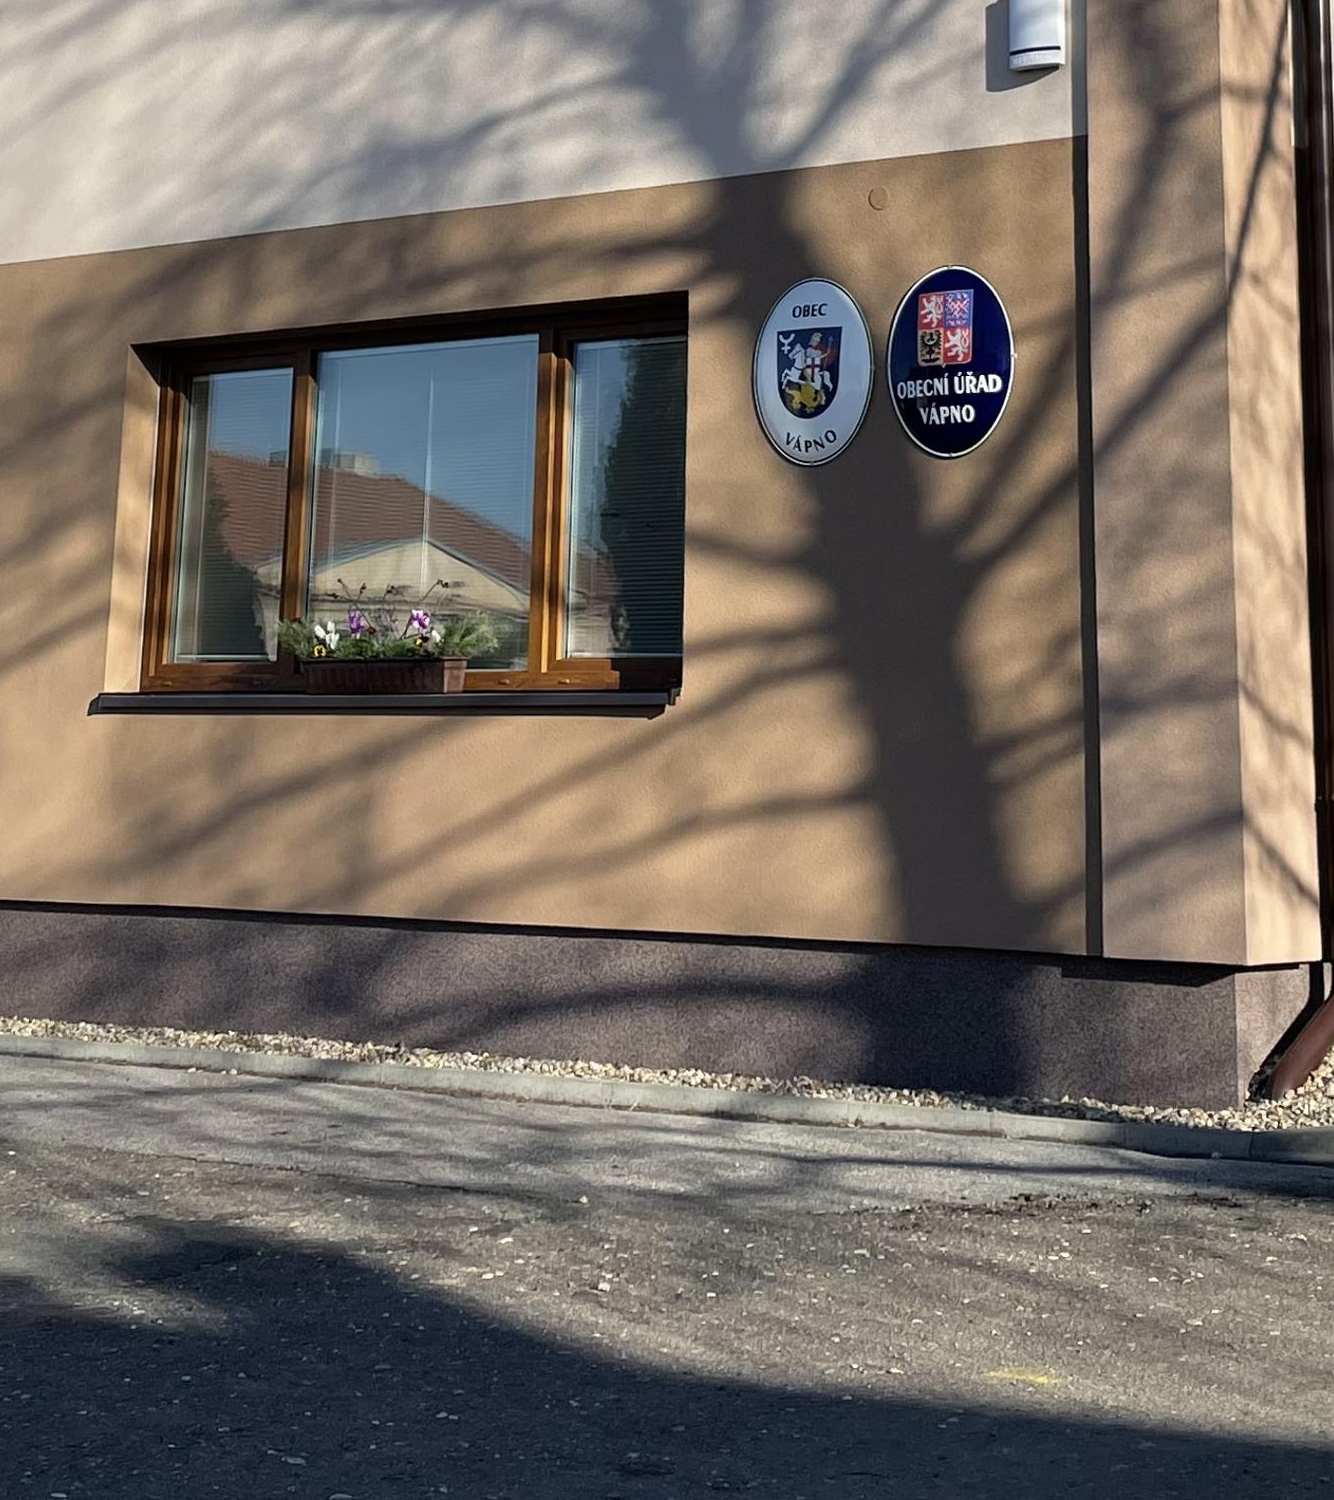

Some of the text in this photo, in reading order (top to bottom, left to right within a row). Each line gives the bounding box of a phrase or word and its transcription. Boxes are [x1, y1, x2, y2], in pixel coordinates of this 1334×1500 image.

[792, 303, 828, 318] OBEC
[897, 371, 1003, 399] OBECNÍ ÚŘAD
[920, 402, 976, 426] VÁPNO
[785, 429, 837, 453] VÁPNO
